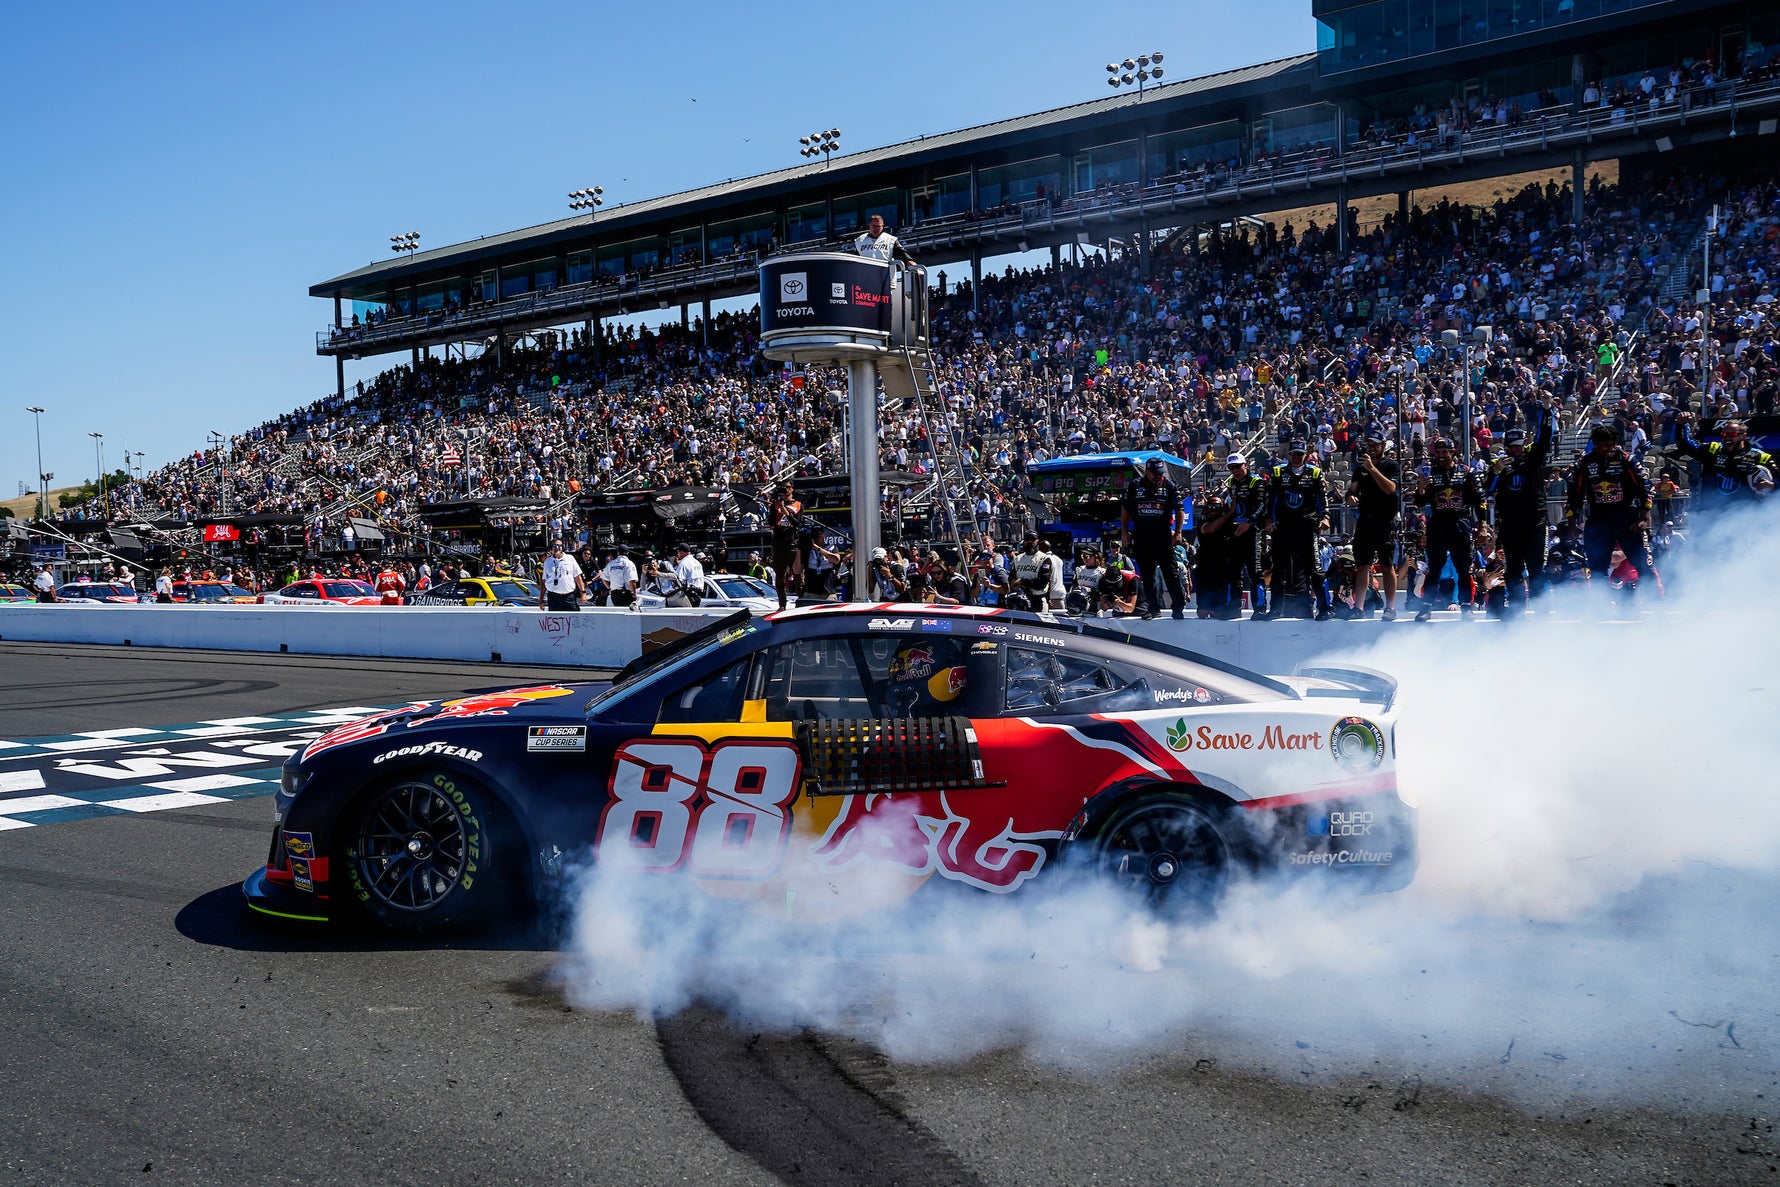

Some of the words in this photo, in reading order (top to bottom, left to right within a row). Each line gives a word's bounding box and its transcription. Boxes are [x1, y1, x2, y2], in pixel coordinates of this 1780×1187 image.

[860, 244, 889, 252] OFFICIAL
[855, 292, 871, 301] SAVE
[872, 294, 889, 304] MART
[776, 306, 815, 318] TOYOTA
[1017, 565, 1038, 573] FFICIAL
[538, 616, 571, 636] WESTY
[1014, 632, 1065, 647] SIEMENS
[1154, 688, 1193, 704] Wendy's
[544, 727, 578, 736] NASCAR
[1196, 725, 1254, 750] Save
[1258, 725, 1323, 751] Mart
[535, 738, 553, 747] CUP
[553, 738, 578, 746] SERIES
[373, 741, 483, 764] GOODYEAR
[594, 736, 803, 877] 88
[1330, 811, 1374, 825] QUAD
[434, 774, 481, 891] GOODYEAR
[1330, 823, 1373, 836] LOCK
[286, 841, 310, 850] SUNOCO
[1289, 849, 1393, 866] SafetyCulture
